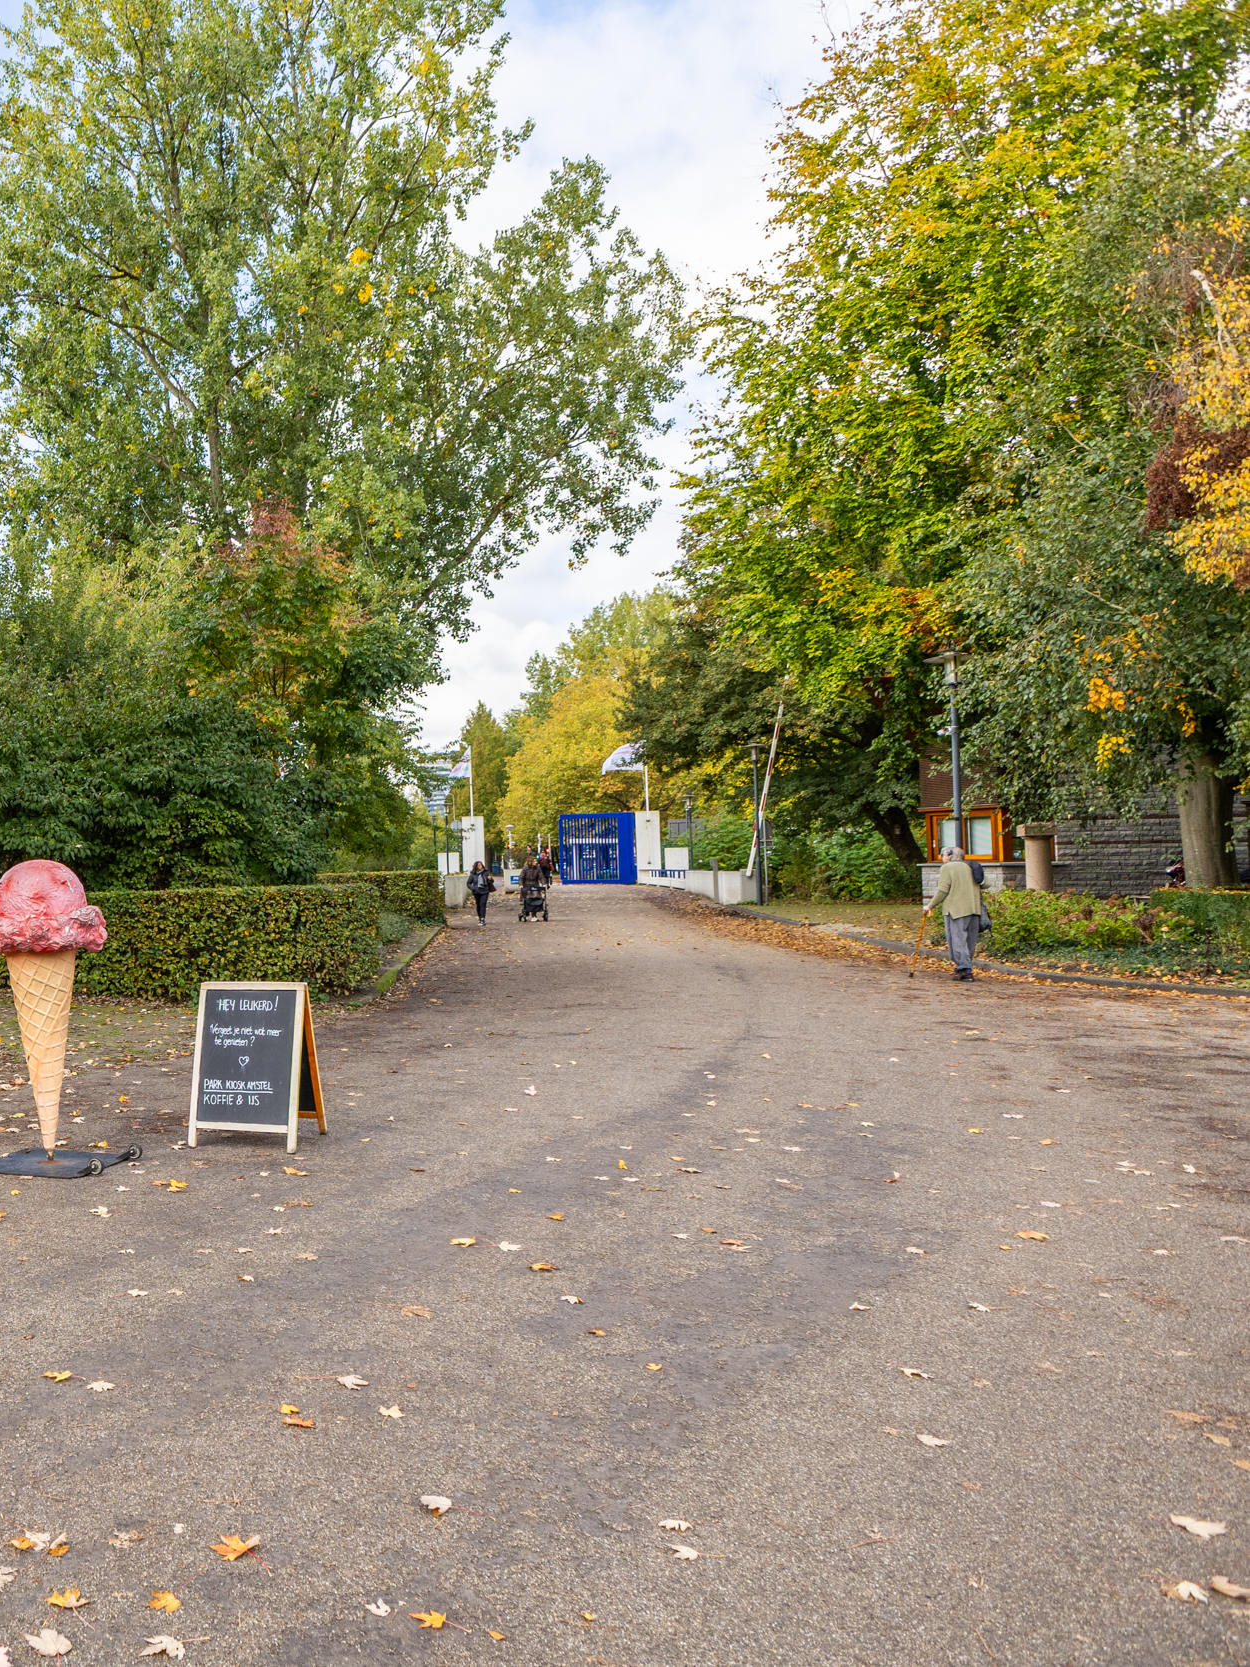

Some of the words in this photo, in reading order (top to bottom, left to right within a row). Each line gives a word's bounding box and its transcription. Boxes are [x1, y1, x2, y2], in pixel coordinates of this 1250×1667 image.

[218, 998, 236, 1011] HEY
[210, 1023, 232, 1037] Vergeet
[233, 1026, 240, 1036] je
[241, 1025, 253, 1035] niet
[254, 1026, 265, 1036] wat
[267, 1029, 282, 1037] meer
[214, 1036, 222, 1046] te
[223, 1037, 248, 1049] genieten
[203, 1078, 223, 1090] PARK
[225, 1079, 246, 1090] KIOSK
[247, 1081, 273, 1091] AMSTEL
[203, 1093, 234, 1105] KOFFIE
[236, 1094, 244, 1106] &
[248, 1095, 260, 1106] IJS
